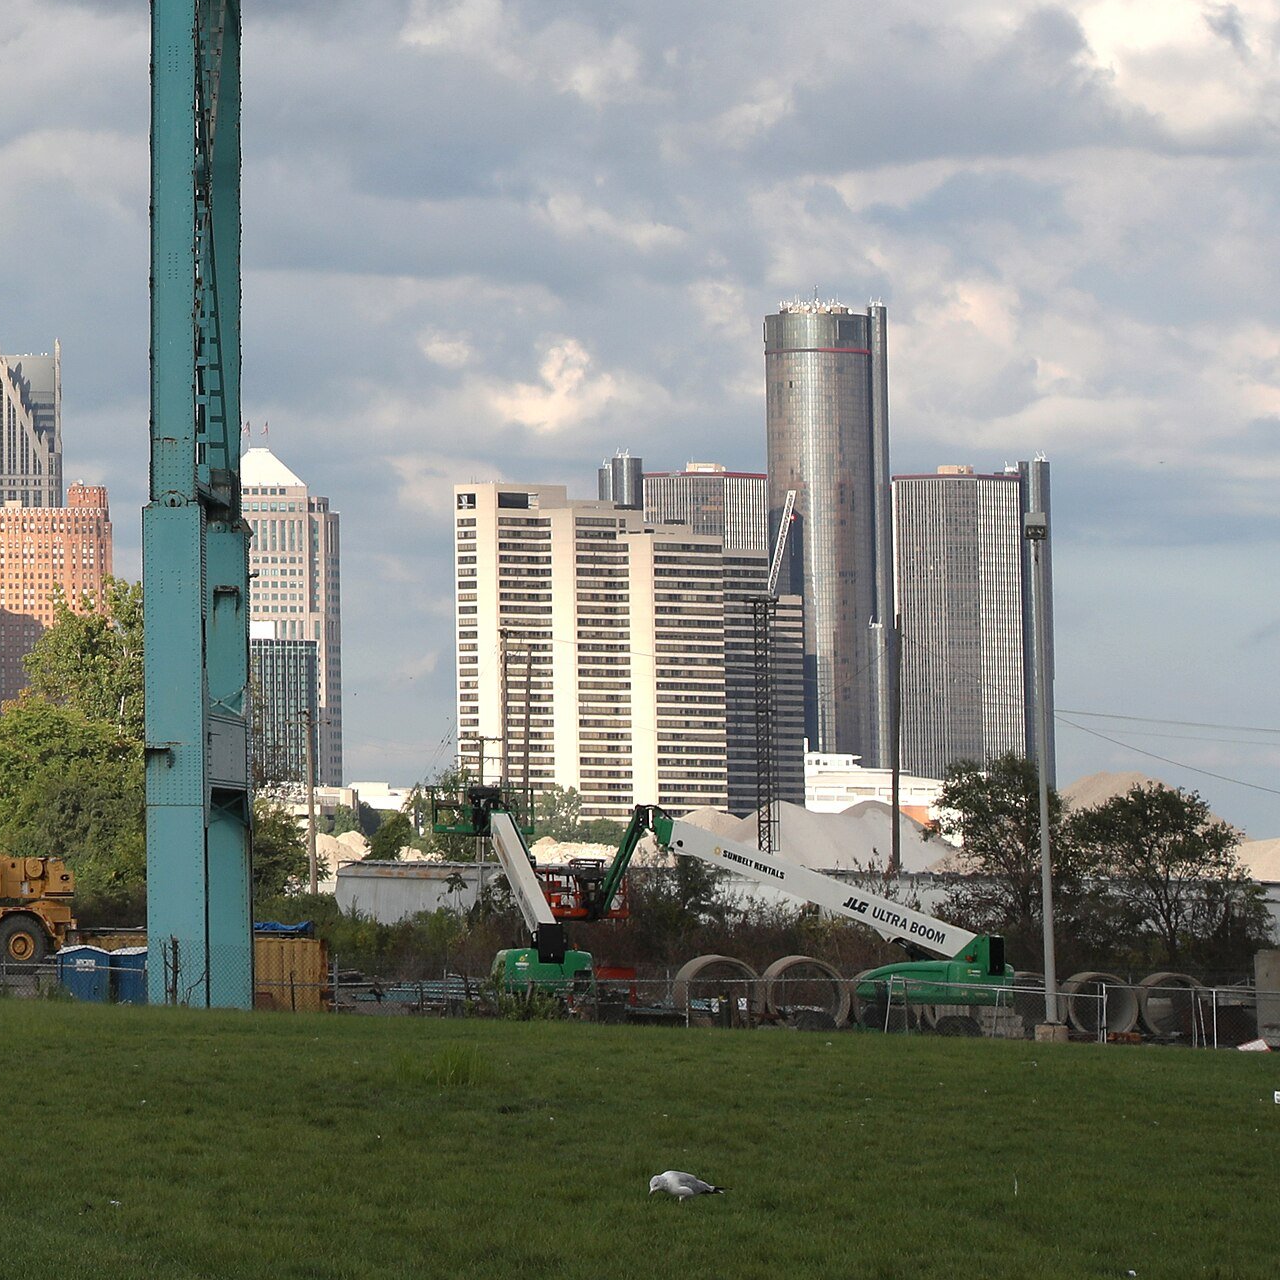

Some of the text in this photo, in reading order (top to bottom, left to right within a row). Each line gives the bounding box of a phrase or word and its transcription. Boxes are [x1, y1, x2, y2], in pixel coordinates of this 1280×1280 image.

[723, 849, 785, 880] SUNBELT RENTALS
[842, 896, 946, 945] JLG ULTRA BOOM
